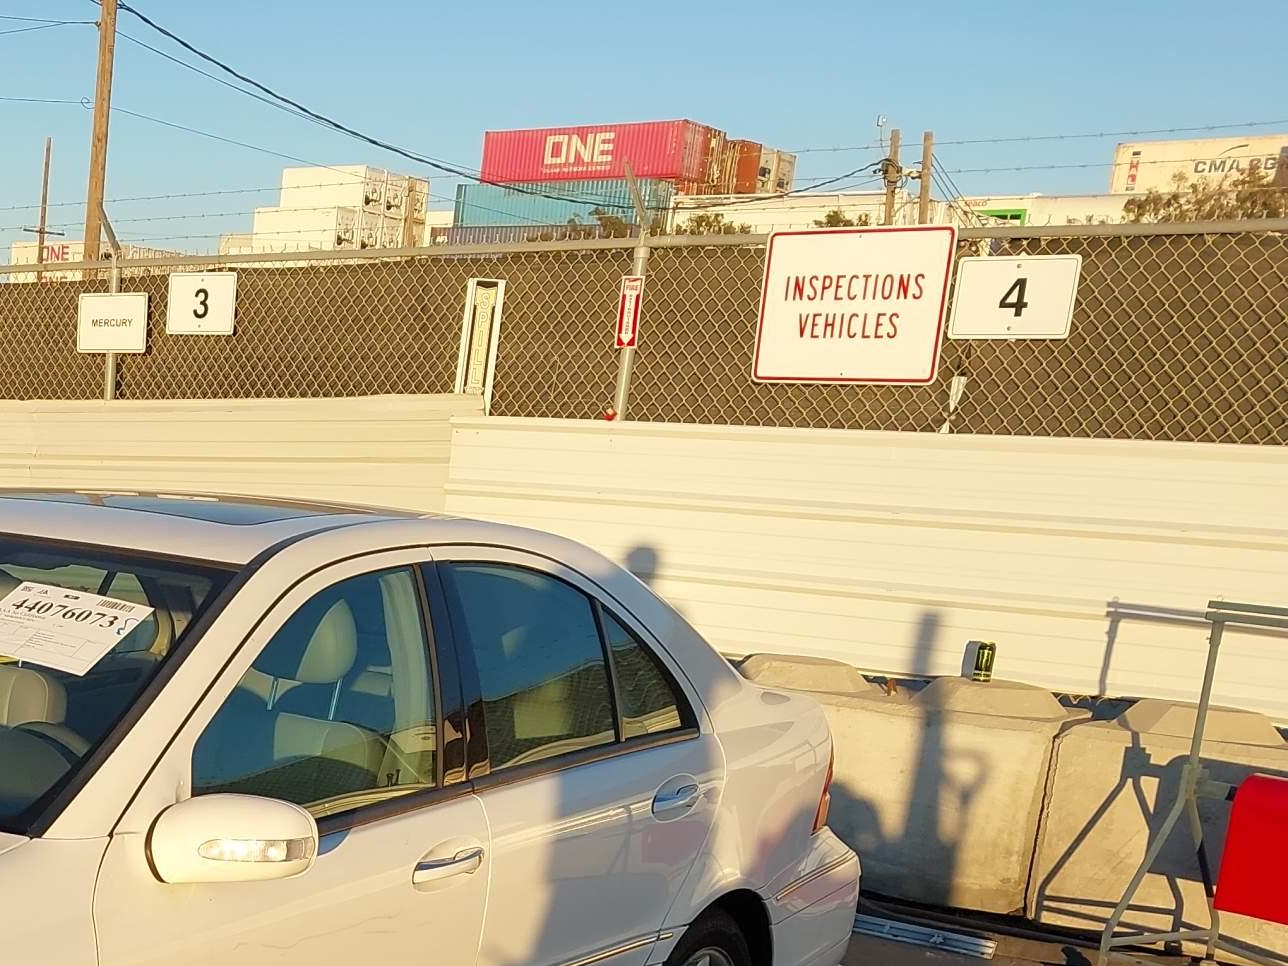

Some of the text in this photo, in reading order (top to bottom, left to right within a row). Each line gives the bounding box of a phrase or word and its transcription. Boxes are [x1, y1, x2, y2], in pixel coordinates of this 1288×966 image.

[544, 132, 615, 164] ONE
[1193, 158, 1241, 174] CMA
[784, 273, 926, 302] INSPECTIONS
[998, 277, 1029, 318] 4
[192, 288, 210, 319] 3
[91, 318, 133, 328] MERCURY
[471, 292, 490, 385] SPILL
[798, 312, 900, 340] VEHICLES
[12, 598, 119, 629] 44076073
